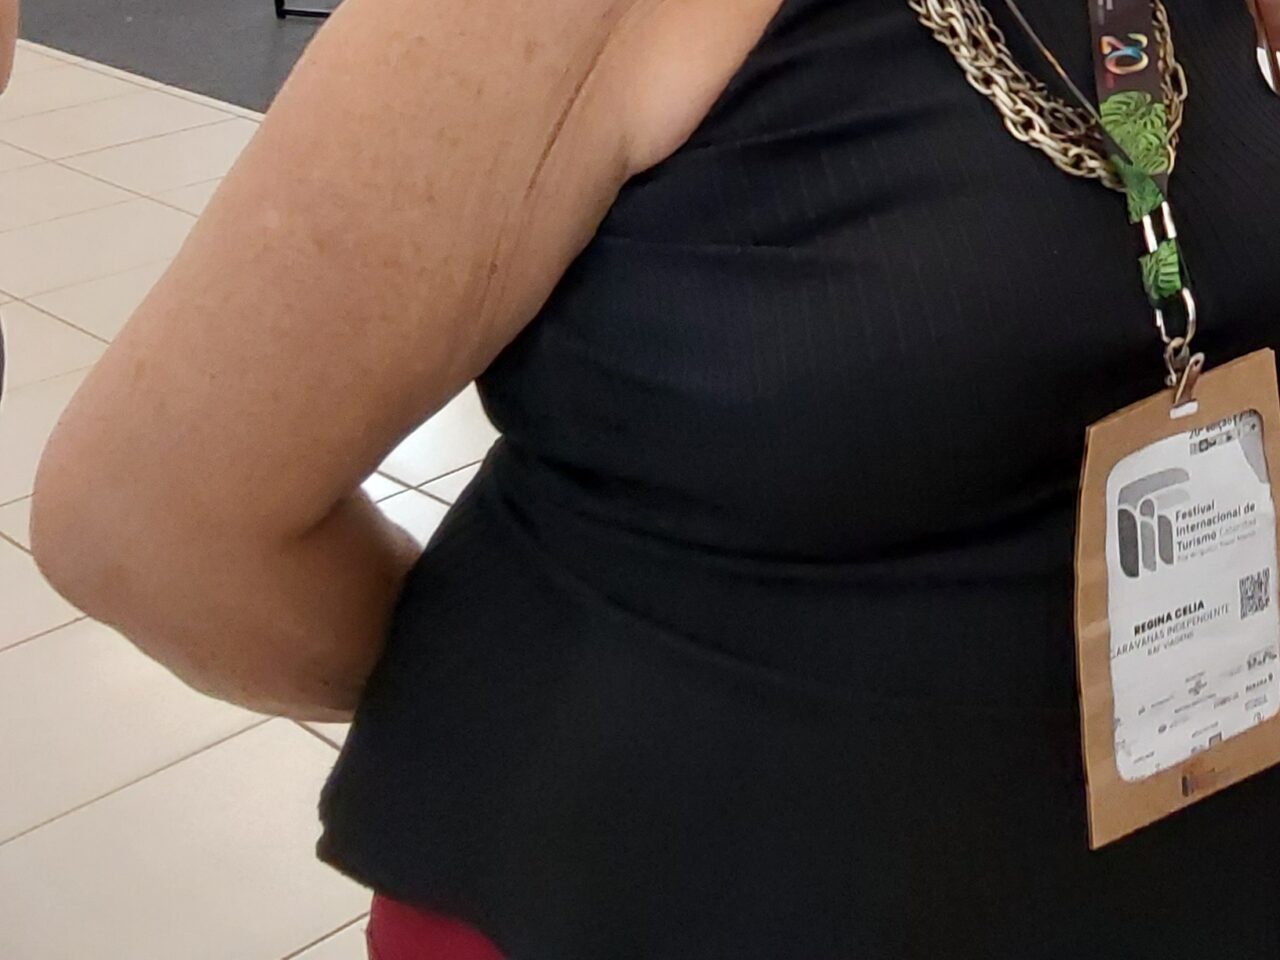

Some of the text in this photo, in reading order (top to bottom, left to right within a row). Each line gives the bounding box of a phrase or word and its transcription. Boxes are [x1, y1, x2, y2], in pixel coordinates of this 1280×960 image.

[1175, 500, 1215, 522] Festival
[1175, 502, 1256, 537] Internacional de
[1176, 530, 1217, 552] Turismo
[1133, 599, 1205, 636] REGINA CELIA
[1112, 630, 1165, 658] ARAVANAS
